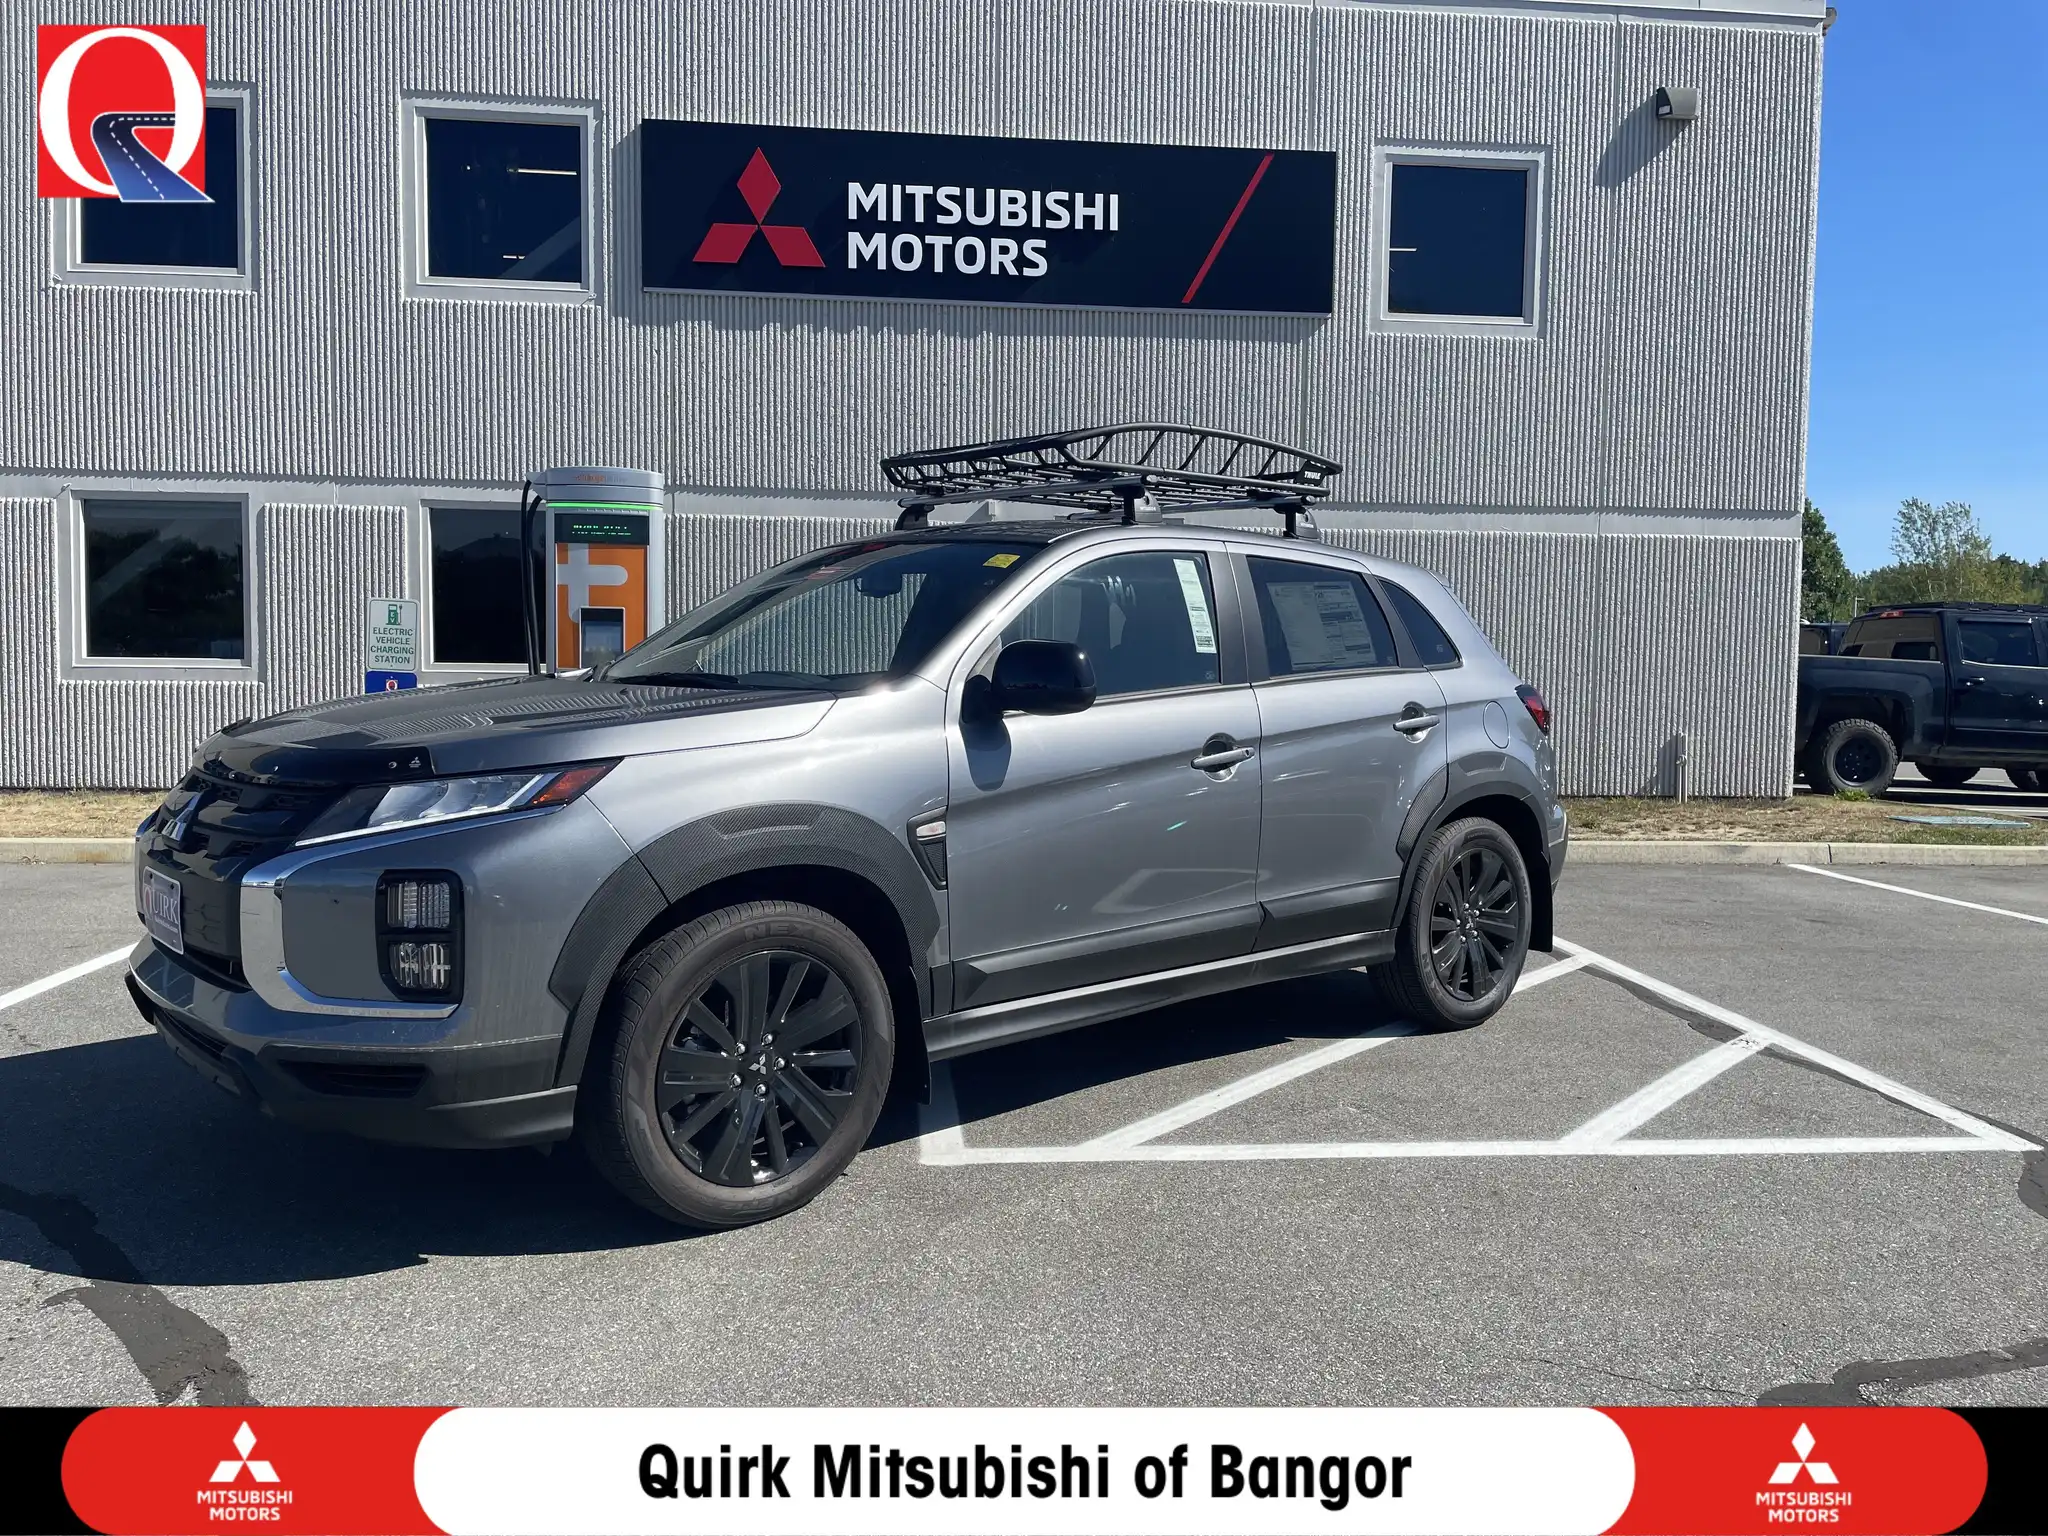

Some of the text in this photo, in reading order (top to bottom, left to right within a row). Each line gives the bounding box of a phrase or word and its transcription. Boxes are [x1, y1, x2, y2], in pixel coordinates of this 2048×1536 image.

[847, 181, 1120, 232] MITSUBISHI
[847, 231, 1048, 278] MOTORS
[372, 626, 413, 636] ELECTRIC
[375, 636, 411, 645] VEHICLE
[370, 645, 414, 655] CHARGING
[374, 655, 411, 664] STATION
[143, 885, 179, 924] QUIRK
